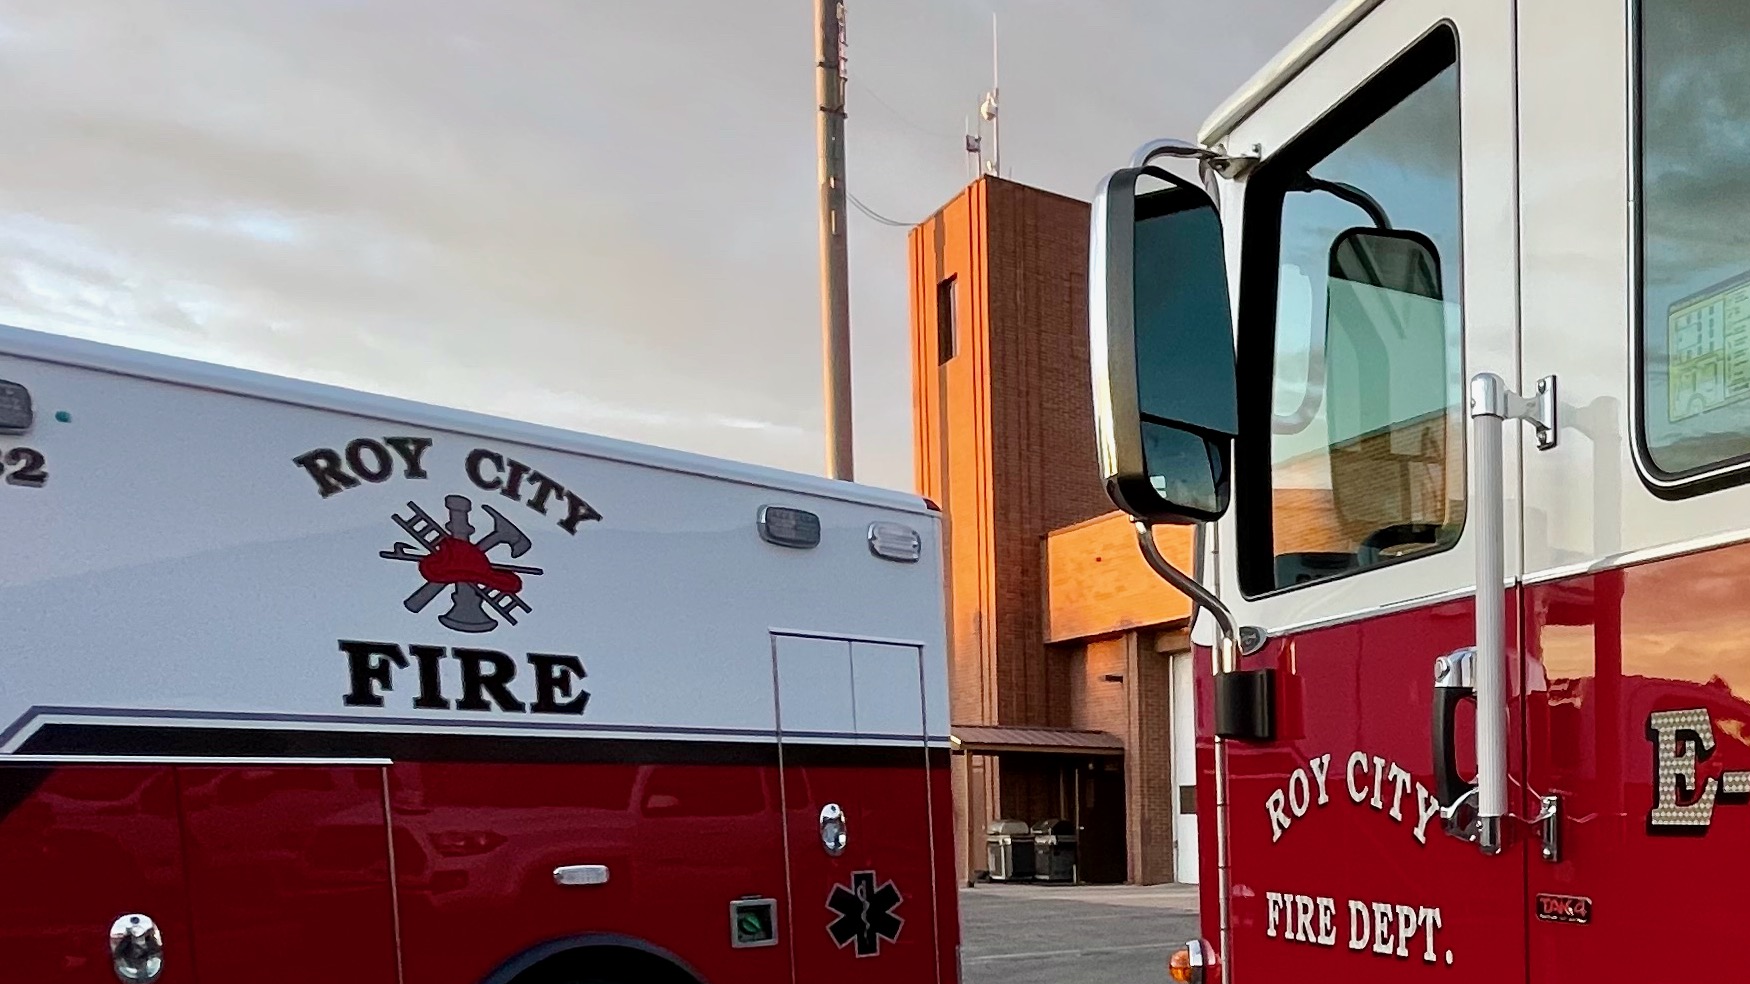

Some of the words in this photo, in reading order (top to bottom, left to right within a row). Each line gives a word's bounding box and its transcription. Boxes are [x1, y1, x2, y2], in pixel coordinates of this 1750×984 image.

[0, 447, 48, 488] 2
[292, 436, 432, 498] ROY
[465, 447, 603, 535] CITY
[337, 639, 591, 714] FIRE
[1264, 752, 1331, 843] ROY
[1346, 750, 1442, 845] CITY
[1265, 891, 1337, 947] FIRE
[1347, 899, 1455, 966] DEPT.
